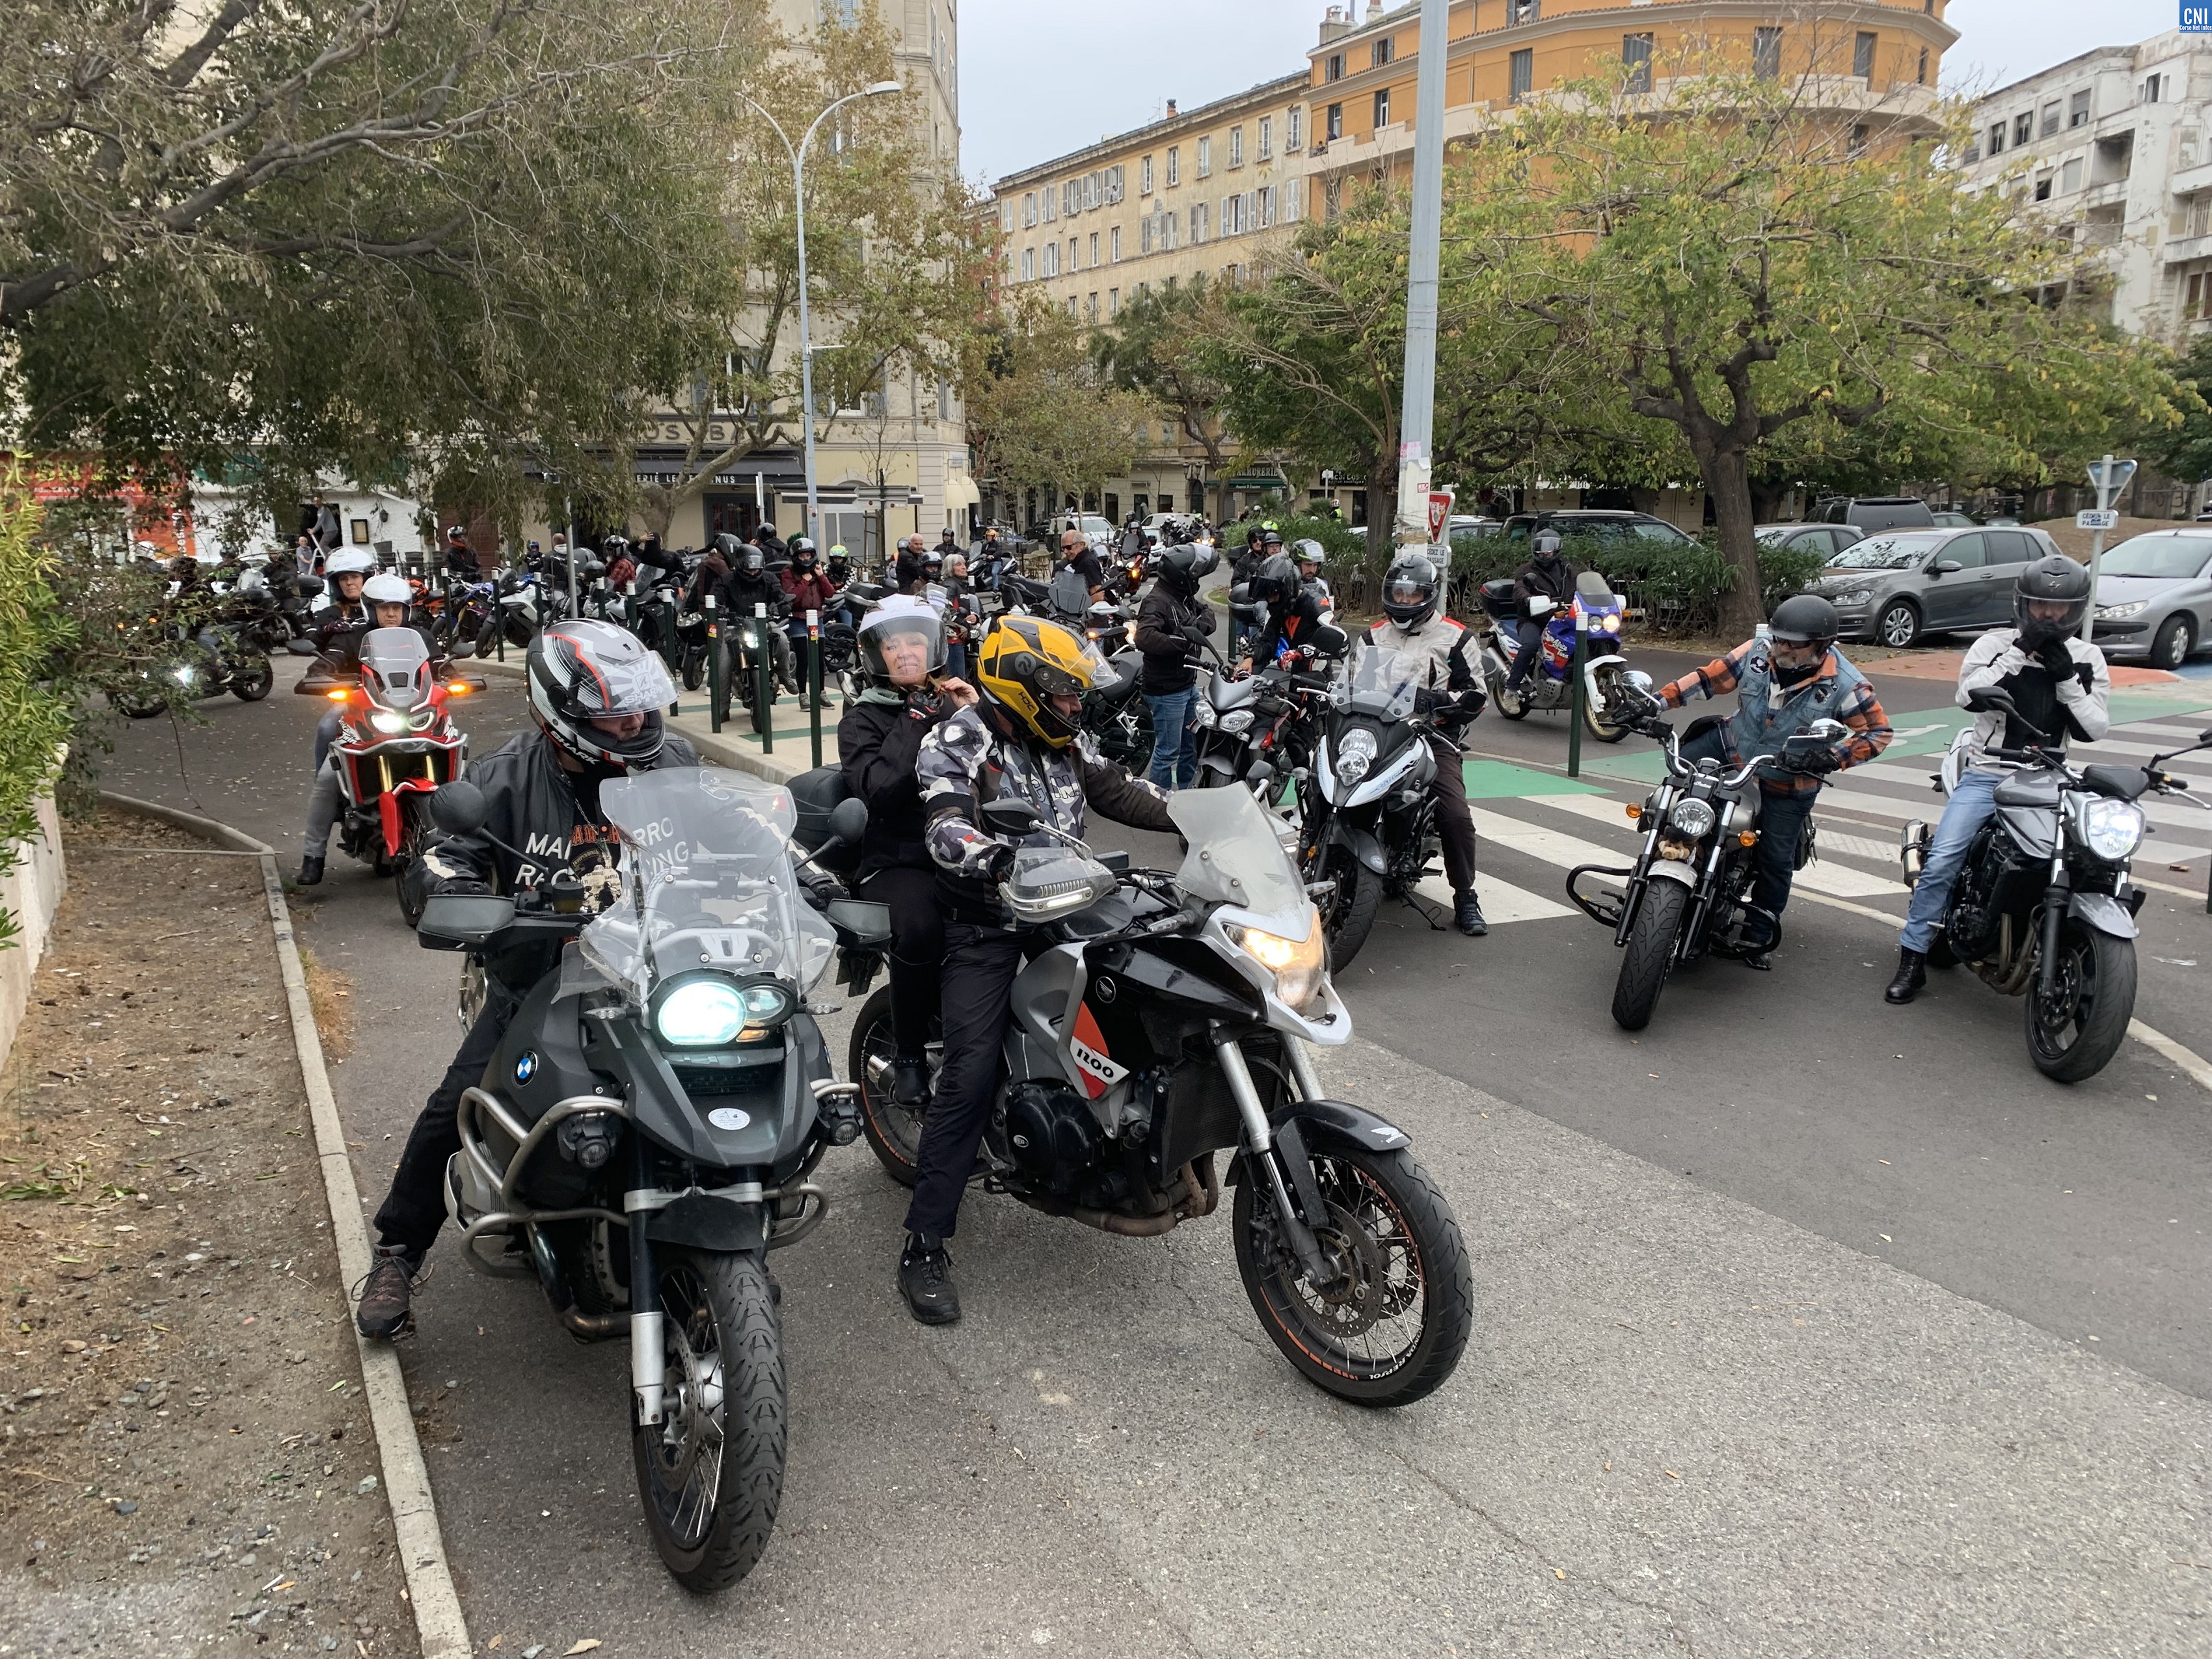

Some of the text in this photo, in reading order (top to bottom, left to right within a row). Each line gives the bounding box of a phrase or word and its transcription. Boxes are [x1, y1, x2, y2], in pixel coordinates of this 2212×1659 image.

[636, 474, 659, 483] ERIE
[625, 685, 664, 705] SHARK
[1018, 692, 1035, 711] HJC
[550, 730, 601, 766] SHARK
[1076, 1047, 1114, 1079] 1200
[1369, 1357, 1406, 1380] REPSOL
